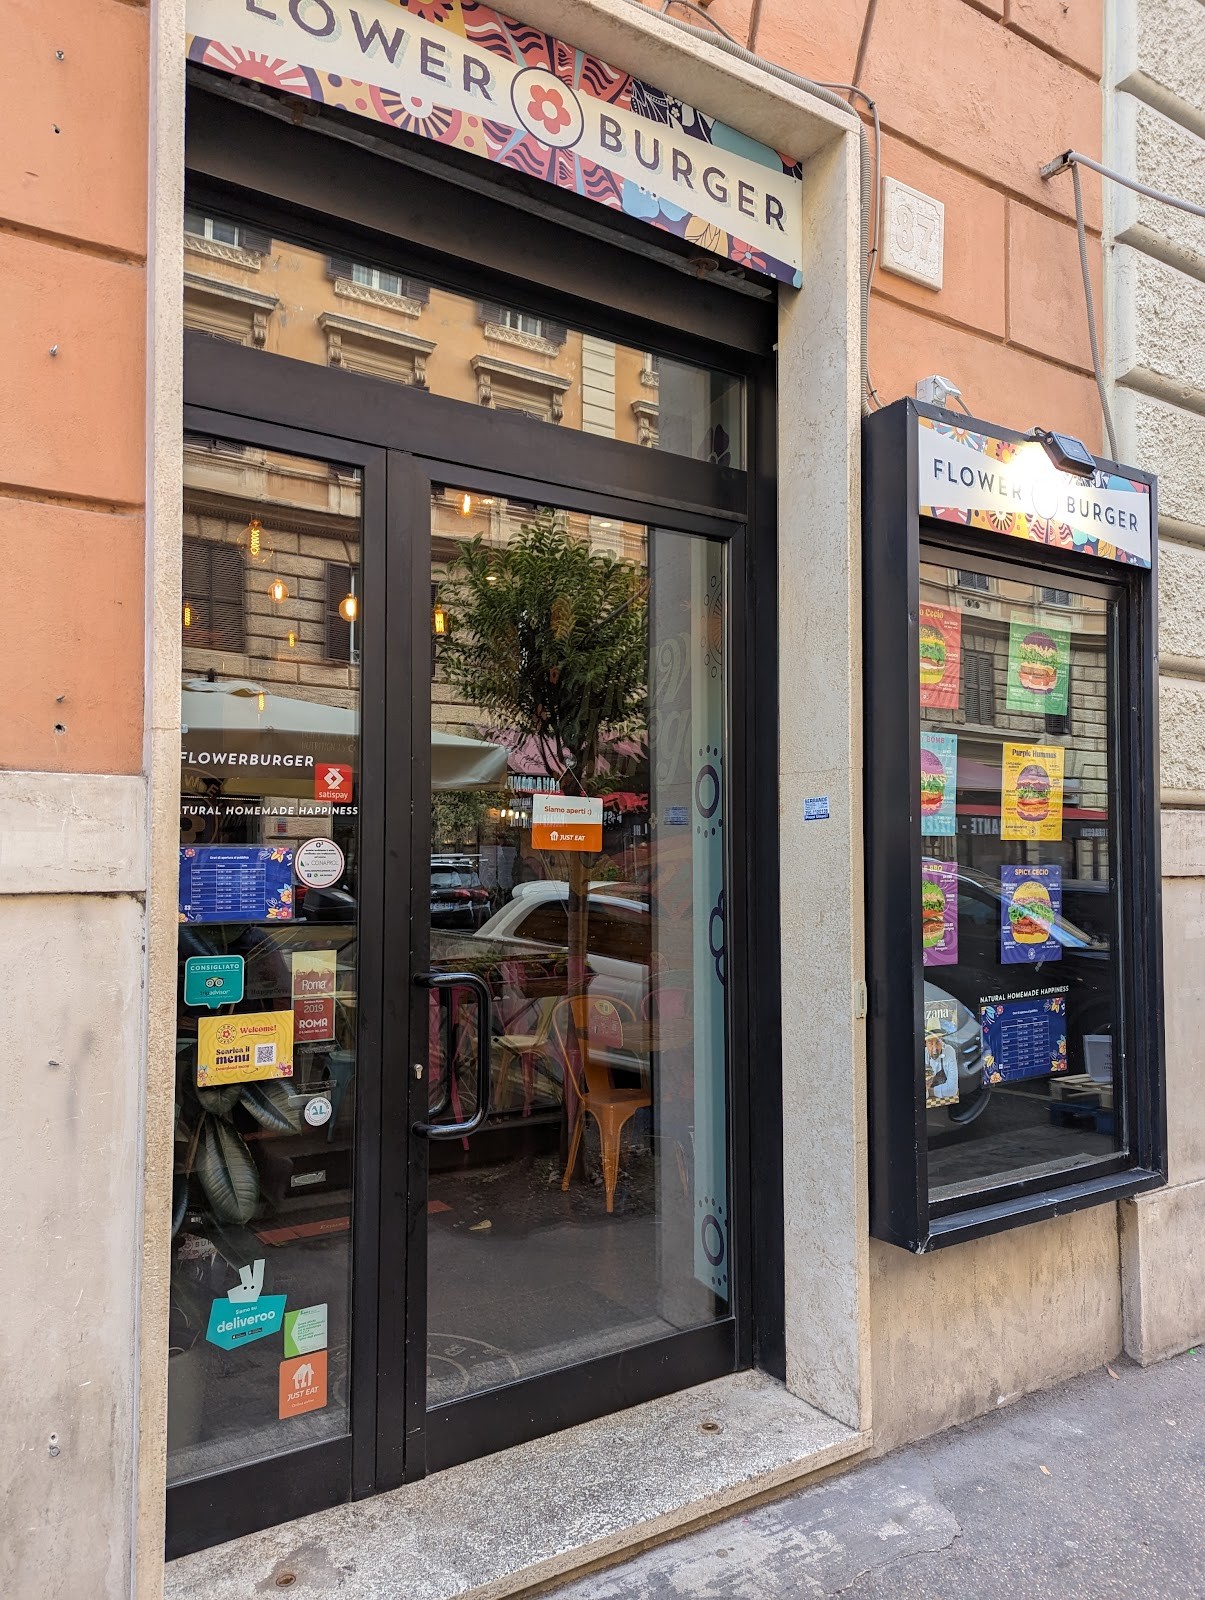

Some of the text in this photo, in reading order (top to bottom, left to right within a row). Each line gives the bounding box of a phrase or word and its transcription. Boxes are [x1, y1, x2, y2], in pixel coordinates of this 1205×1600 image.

[600, 113, 785, 232] BURGER
[896, 204, 935, 261] 87
[934, 458, 1138, 531] FLOWER BURGER
[926, 736, 945, 744] BOMB
[1012, 749, 1057, 759] Purple Hummus
[180, 752, 314, 767] FLOWERBURGER
[319, 791, 348, 800] satispay
[226, 806, 294, 815] HOMEMADE
[299, 806, 359, 815] HAPPINESS
[190, 963, 240, 971] CONSIGLIATO
[302, 979, 326, 991] Roma
[980, 985, 1070, 1003] NATURAL HOMEMADE HAPPINESS
[304, 1004, 324, 1013] 2019
[299, 1018, 327, 1029] ROMA
[240, 1025, 277, 1034] Welcome!
[216, 1047, 243, 1055] Scarica
[216, 1054, 250, 1064] menu
[217, 1311, 275, 1333] deliveroo
[287, 1386, 319, 1402] JUST EAT
